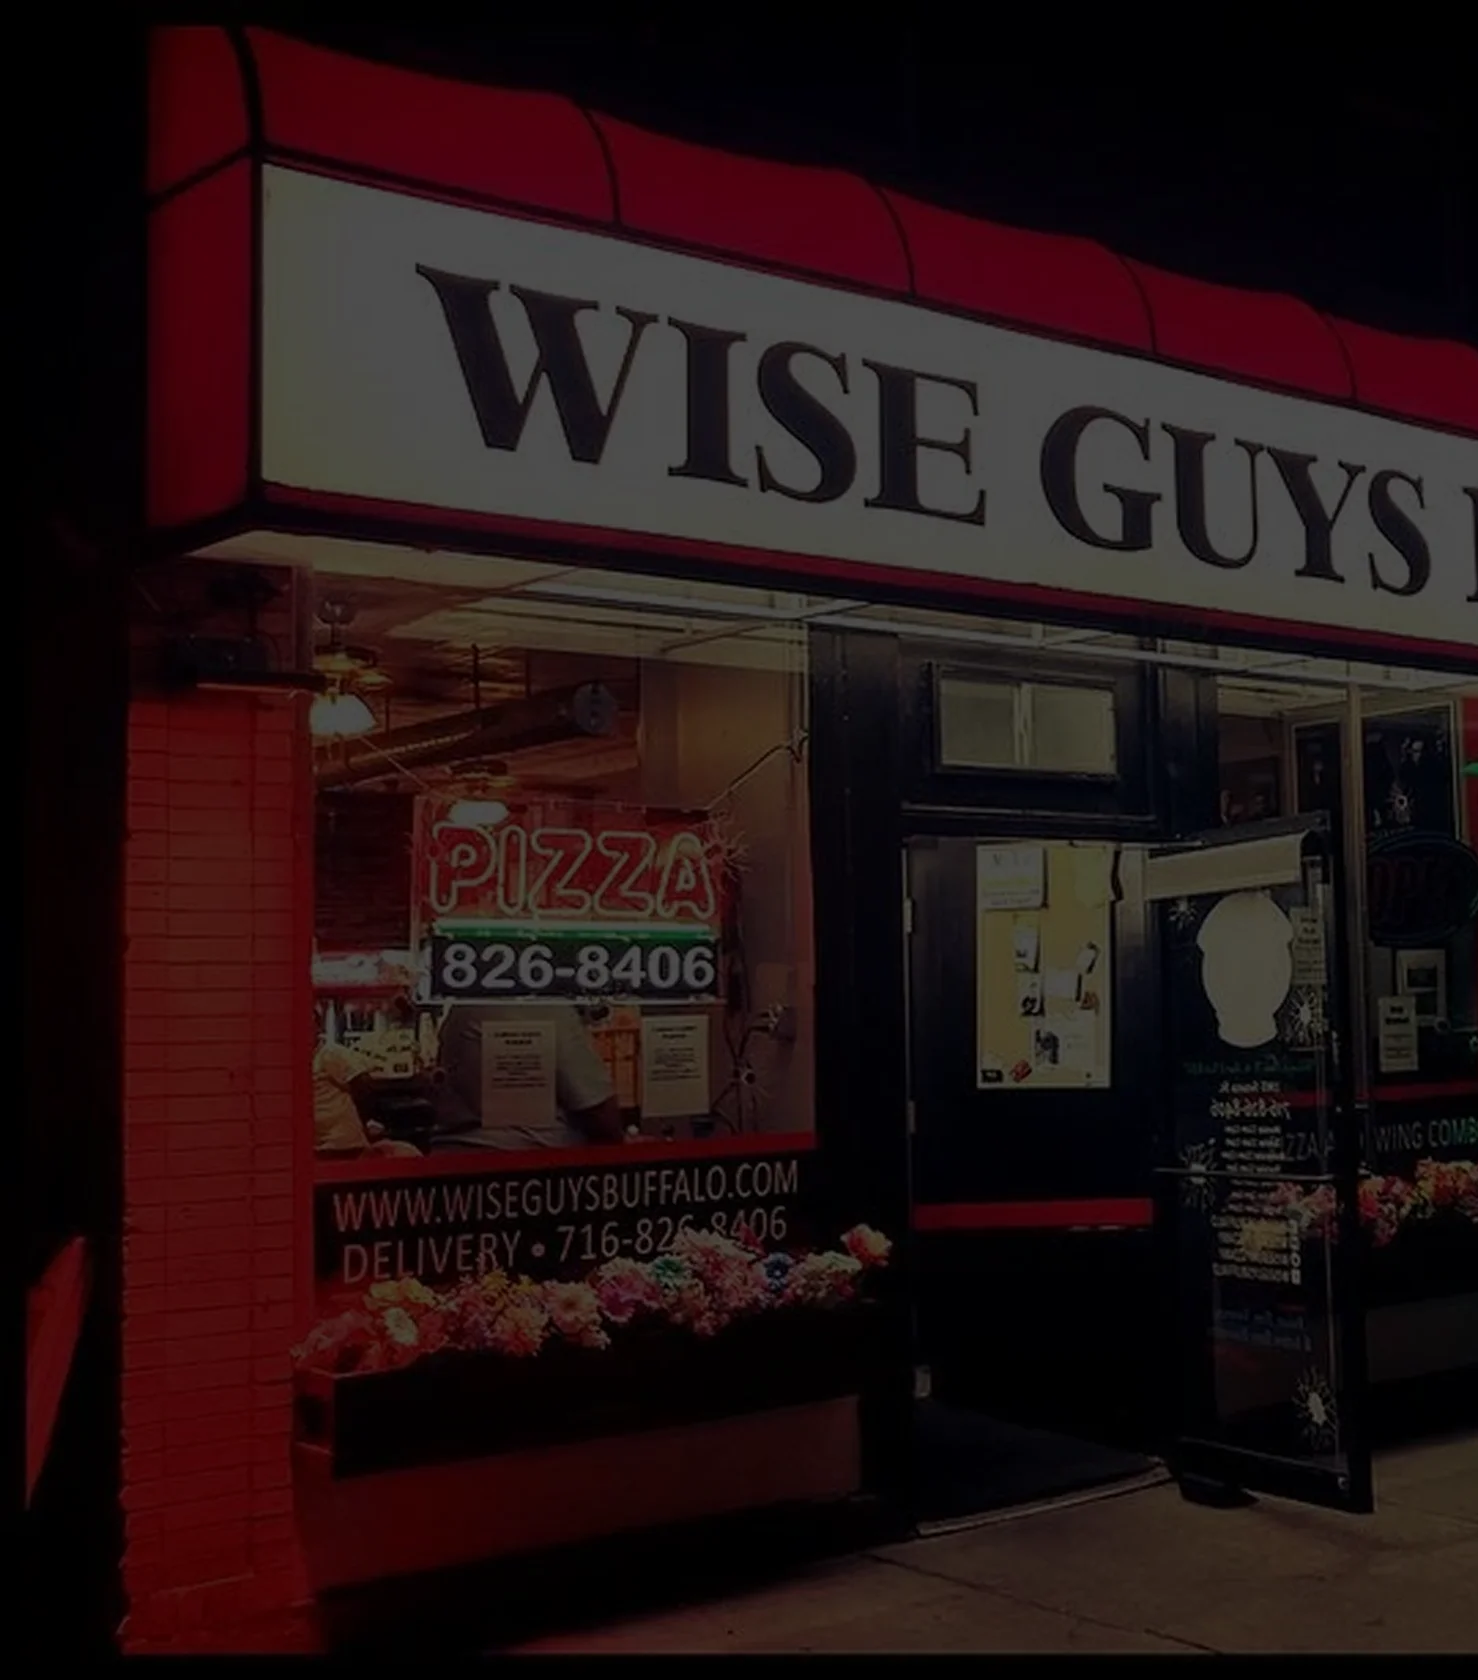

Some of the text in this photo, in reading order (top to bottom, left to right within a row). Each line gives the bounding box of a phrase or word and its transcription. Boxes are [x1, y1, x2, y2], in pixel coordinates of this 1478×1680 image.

[415, 262, 987, 526] WISE
[1039, 404, 1432, 598] GUYS
[428, 824, 716, 918] PIZZA
[441, 942, 716, 990] 826-8406
[1373, 1120, 1423, 1151] WING
[332, 1160, 799, 1232] WWW.WISEGUYSBUFFALO.COM
[343, 1229, 521, 1284] DELIVERY
